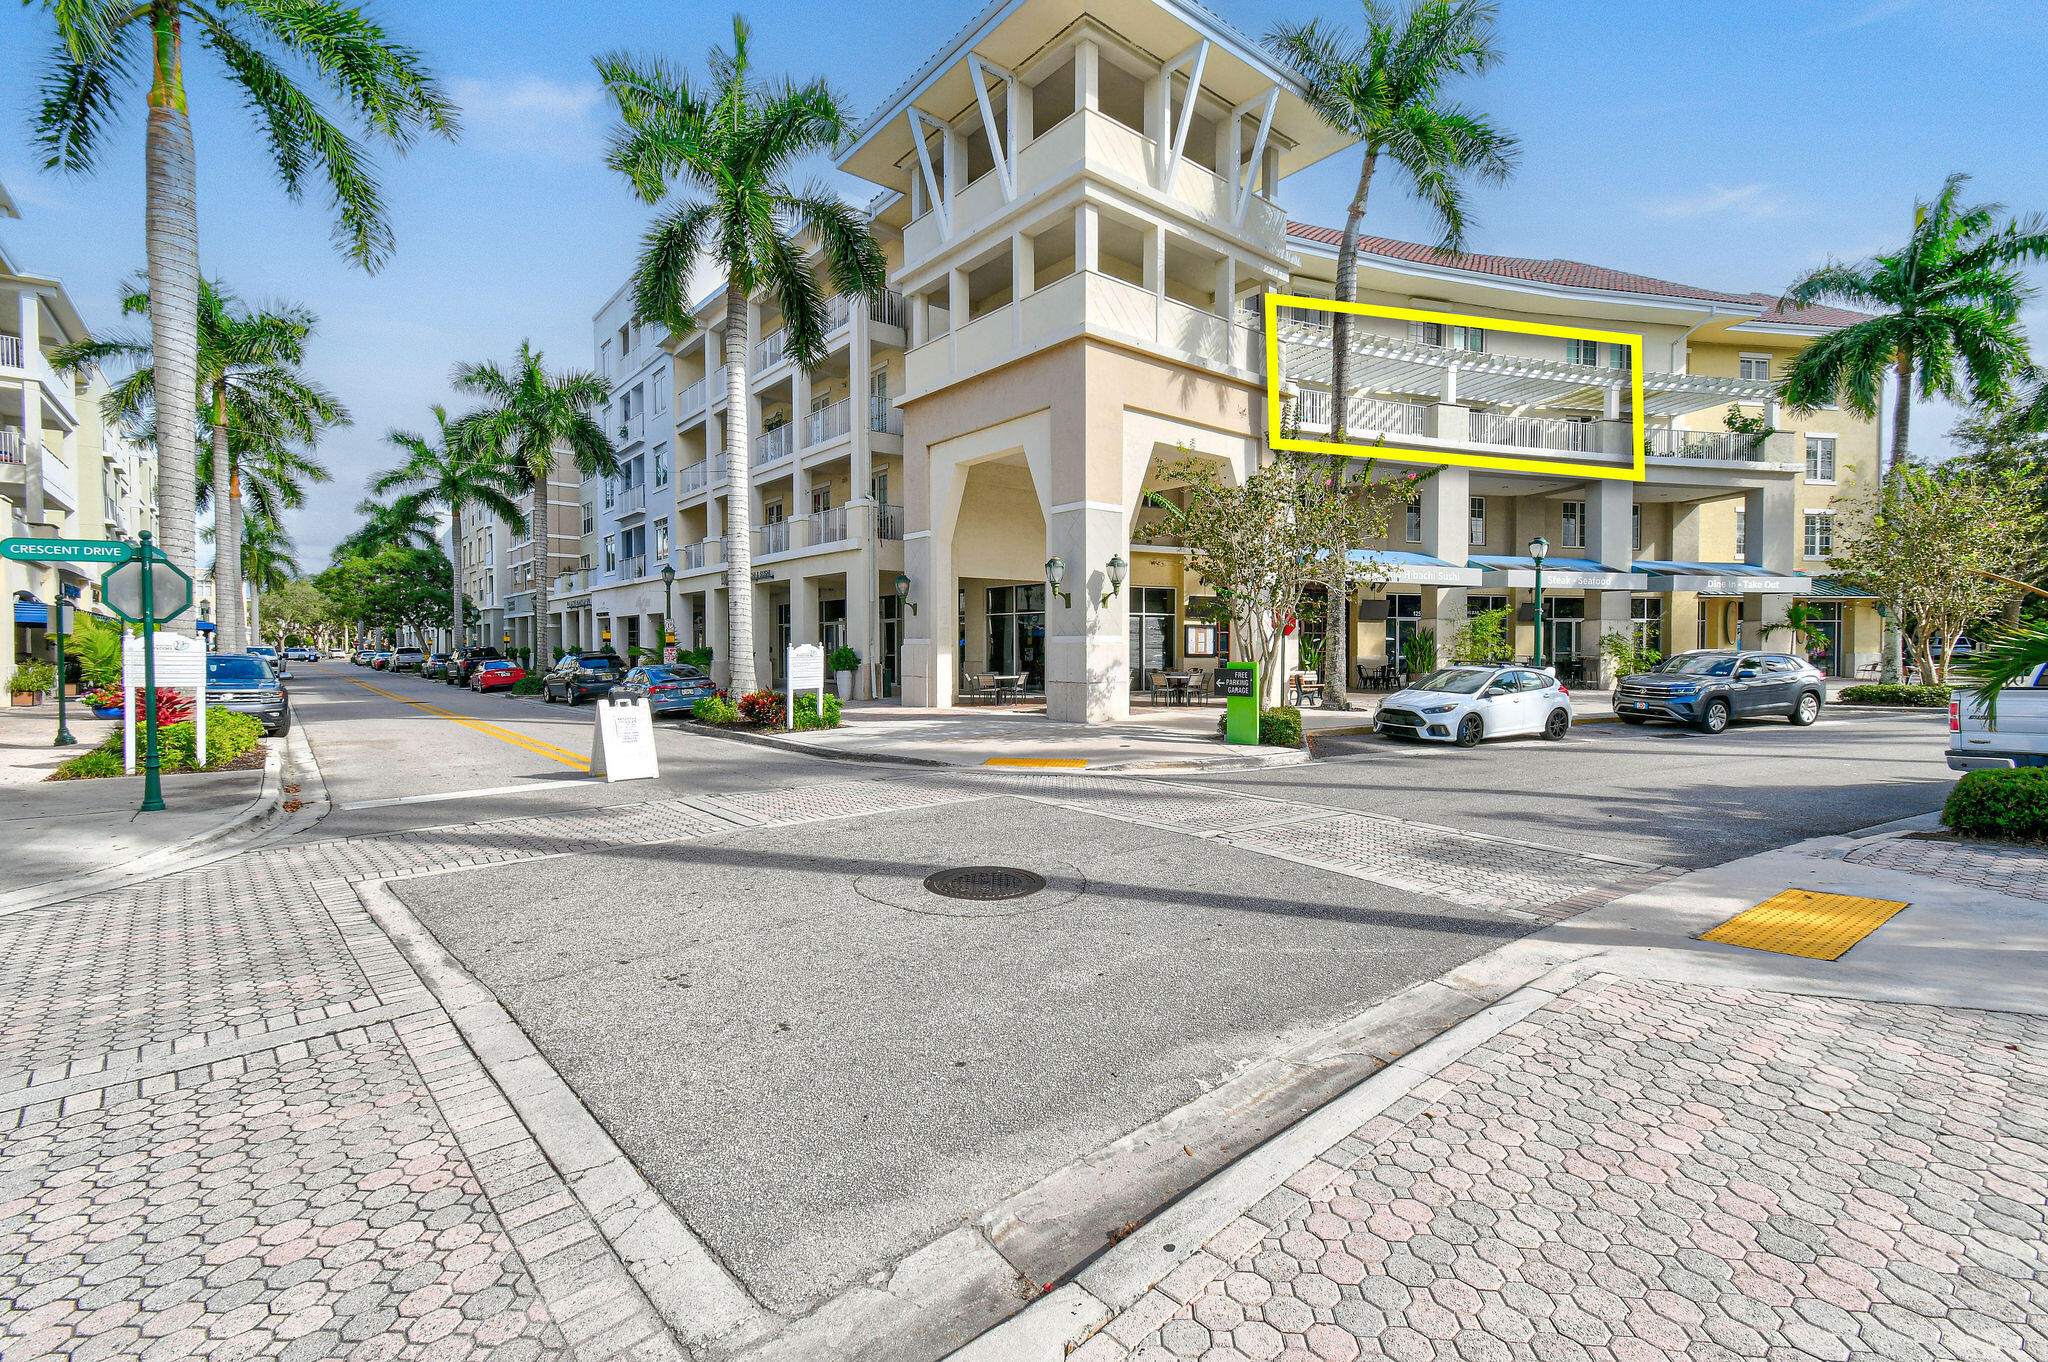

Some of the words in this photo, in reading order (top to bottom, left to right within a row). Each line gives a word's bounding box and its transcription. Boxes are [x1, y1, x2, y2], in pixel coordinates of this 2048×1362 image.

[10, 544, 80, 555] CRESCENT
[83, 546, 121, 556] DRIVE
[1404, 569, 1436, 580] Hibachi
[1438, 570, 1460, 581] Sushi
[1547, 575, 1572, 585] Steak
[1577, 576, 1612, 586] Seafood
[1707, 579, 1726, 588] Dine
[1728, 580, 1736, 588] In
[1743, 580, 1762, 589] Take
[1764, 580, 1780, 589] Out
[1234, 671, 1248, 679] FREE
[1227, 686, 1249, 694] GARAGE
